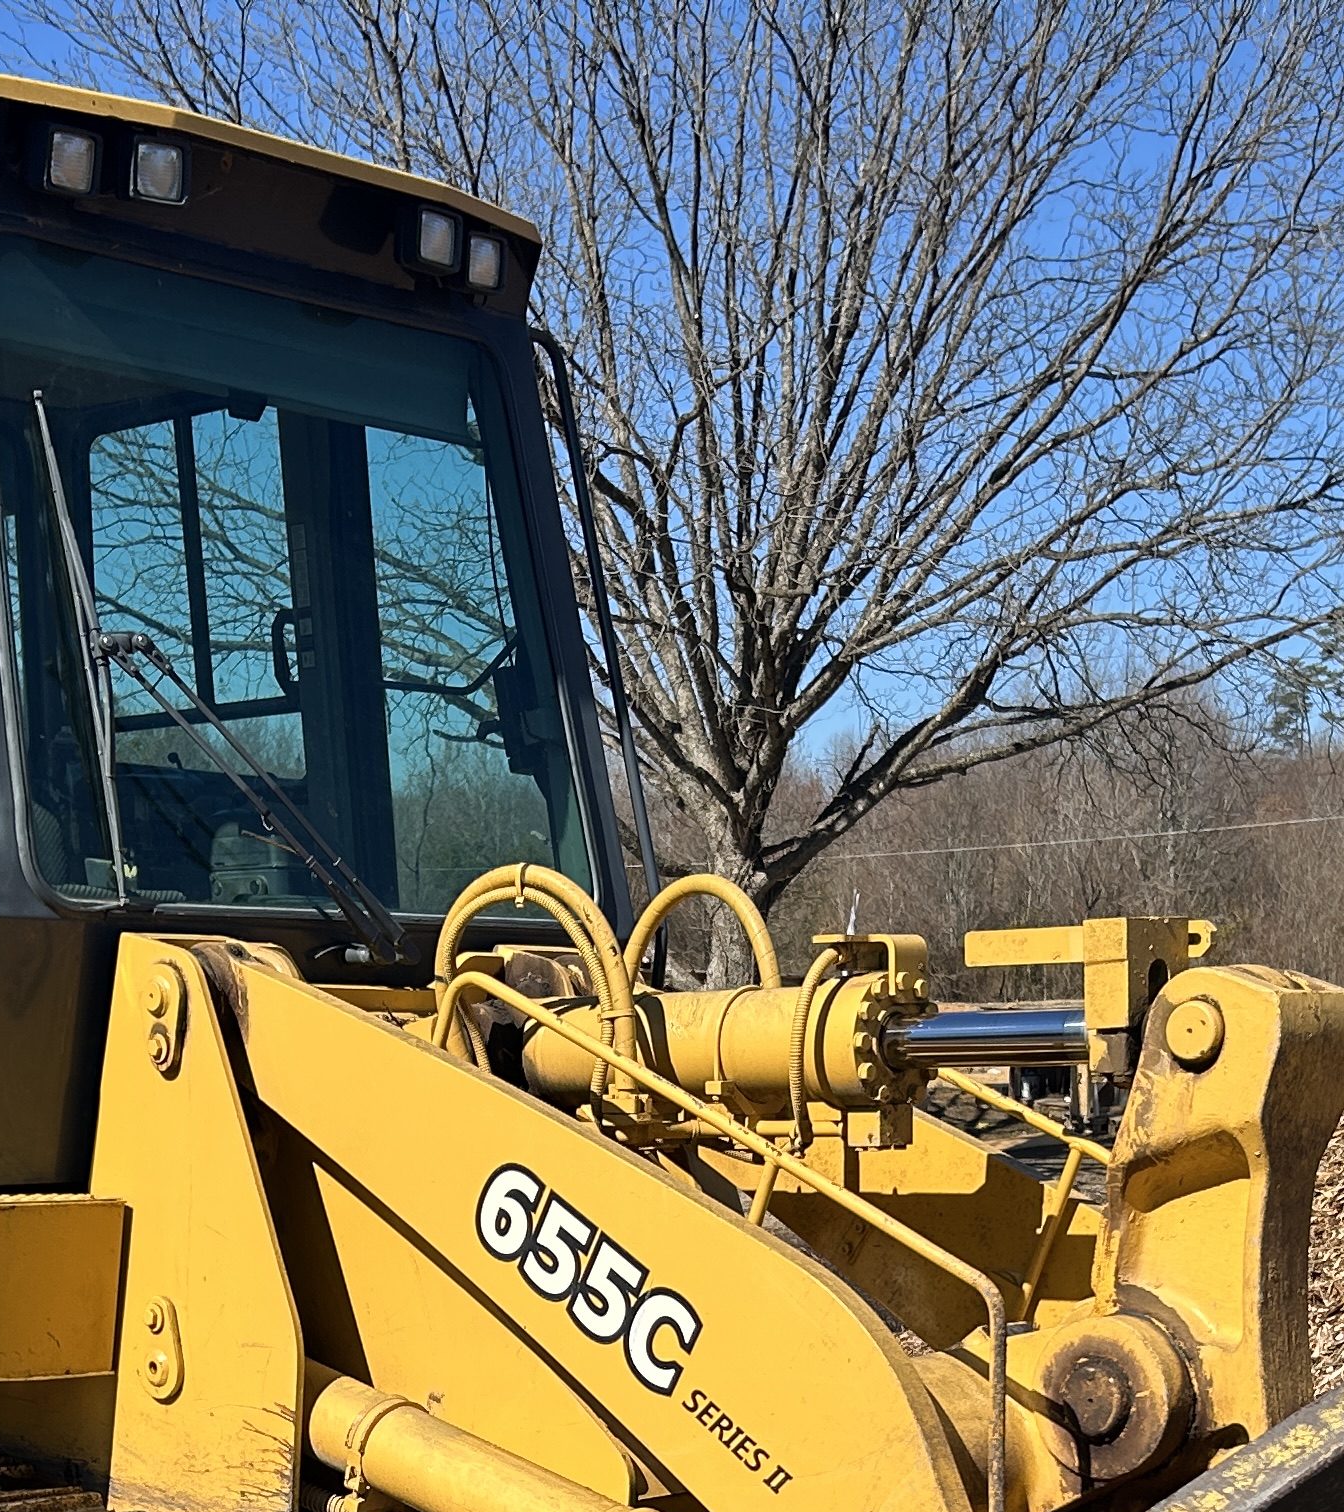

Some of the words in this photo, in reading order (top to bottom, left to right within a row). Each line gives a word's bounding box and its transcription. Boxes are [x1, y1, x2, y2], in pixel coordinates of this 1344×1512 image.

[475, 1162, 703, 1397] 655C
[681, 1389, 770, 1472] SERIES
[762, 1465, 793, 1494] II
